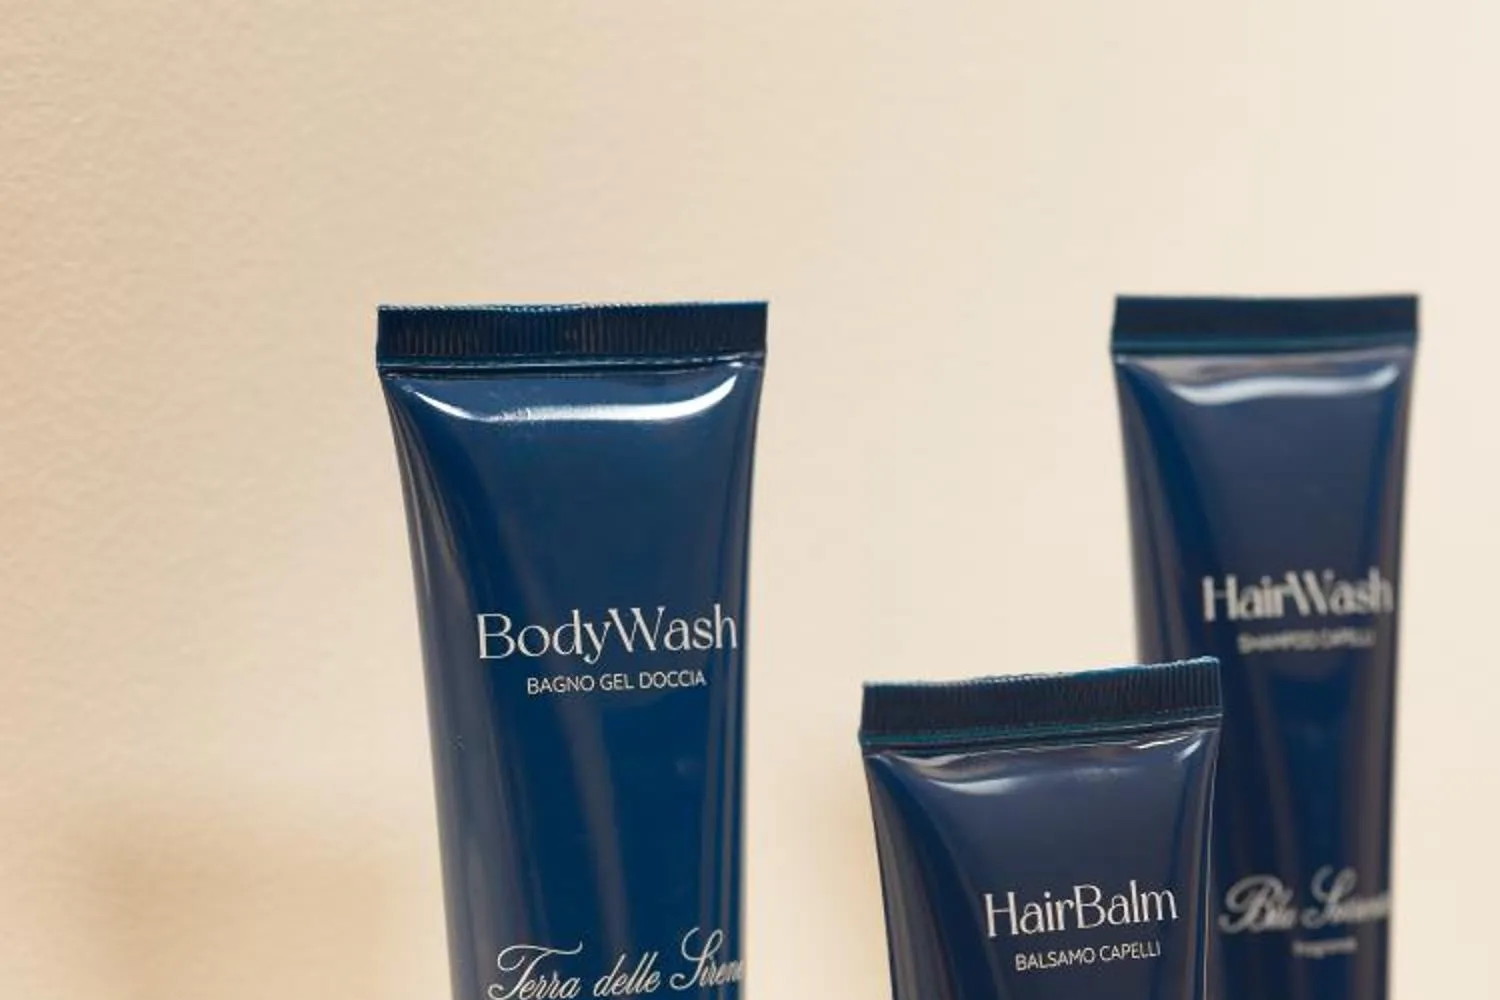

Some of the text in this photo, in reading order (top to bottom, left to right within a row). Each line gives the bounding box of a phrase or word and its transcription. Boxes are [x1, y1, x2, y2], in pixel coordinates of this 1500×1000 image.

[1202, 566, 1395, 621] HairWash
[476, 603, 738, 664] BodyWash
[527, 670, 707, 695] BAGNO GEL DOCCIA
[982, 879, 1179, 938] HairBalm
[487, 927, 744, 1000] Terra delle Siren
[1015, 940, 1162, 972] BALSAMO CAPELLI
